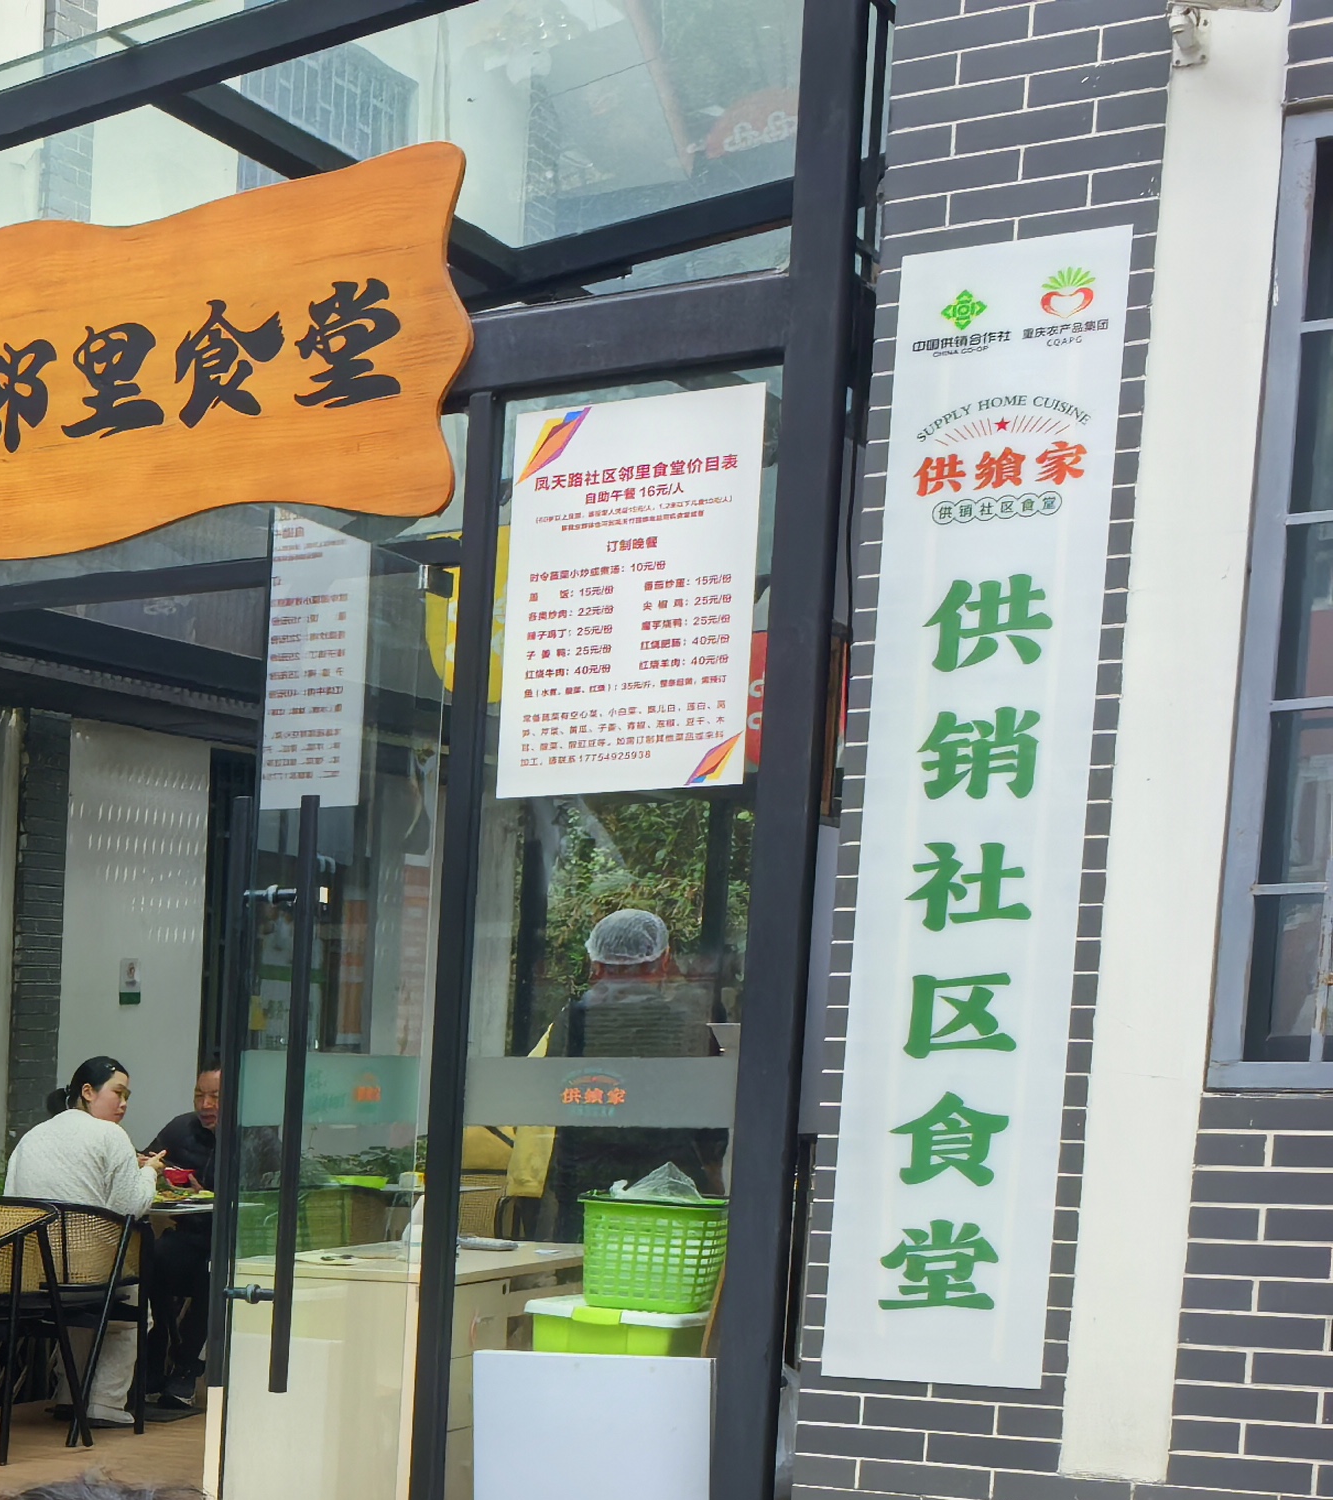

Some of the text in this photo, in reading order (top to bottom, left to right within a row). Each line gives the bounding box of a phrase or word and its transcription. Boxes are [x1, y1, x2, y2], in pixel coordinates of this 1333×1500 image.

[1022, 318, 1110, 340] 重庆农产品集团
[911, 330, 1012, 353] 中国供销合作社
[916, 394, 1092, 443] SUPPLY HOME CUISINE
[534, 453, 739, 492] 凤天路社区邻里食堂价目表
[638, 482, 685, 498] 16元/人
[937, 496, 1058, 519] 供销社区食堂
[878, 573, 1053, 1311] 供销社区食堂
